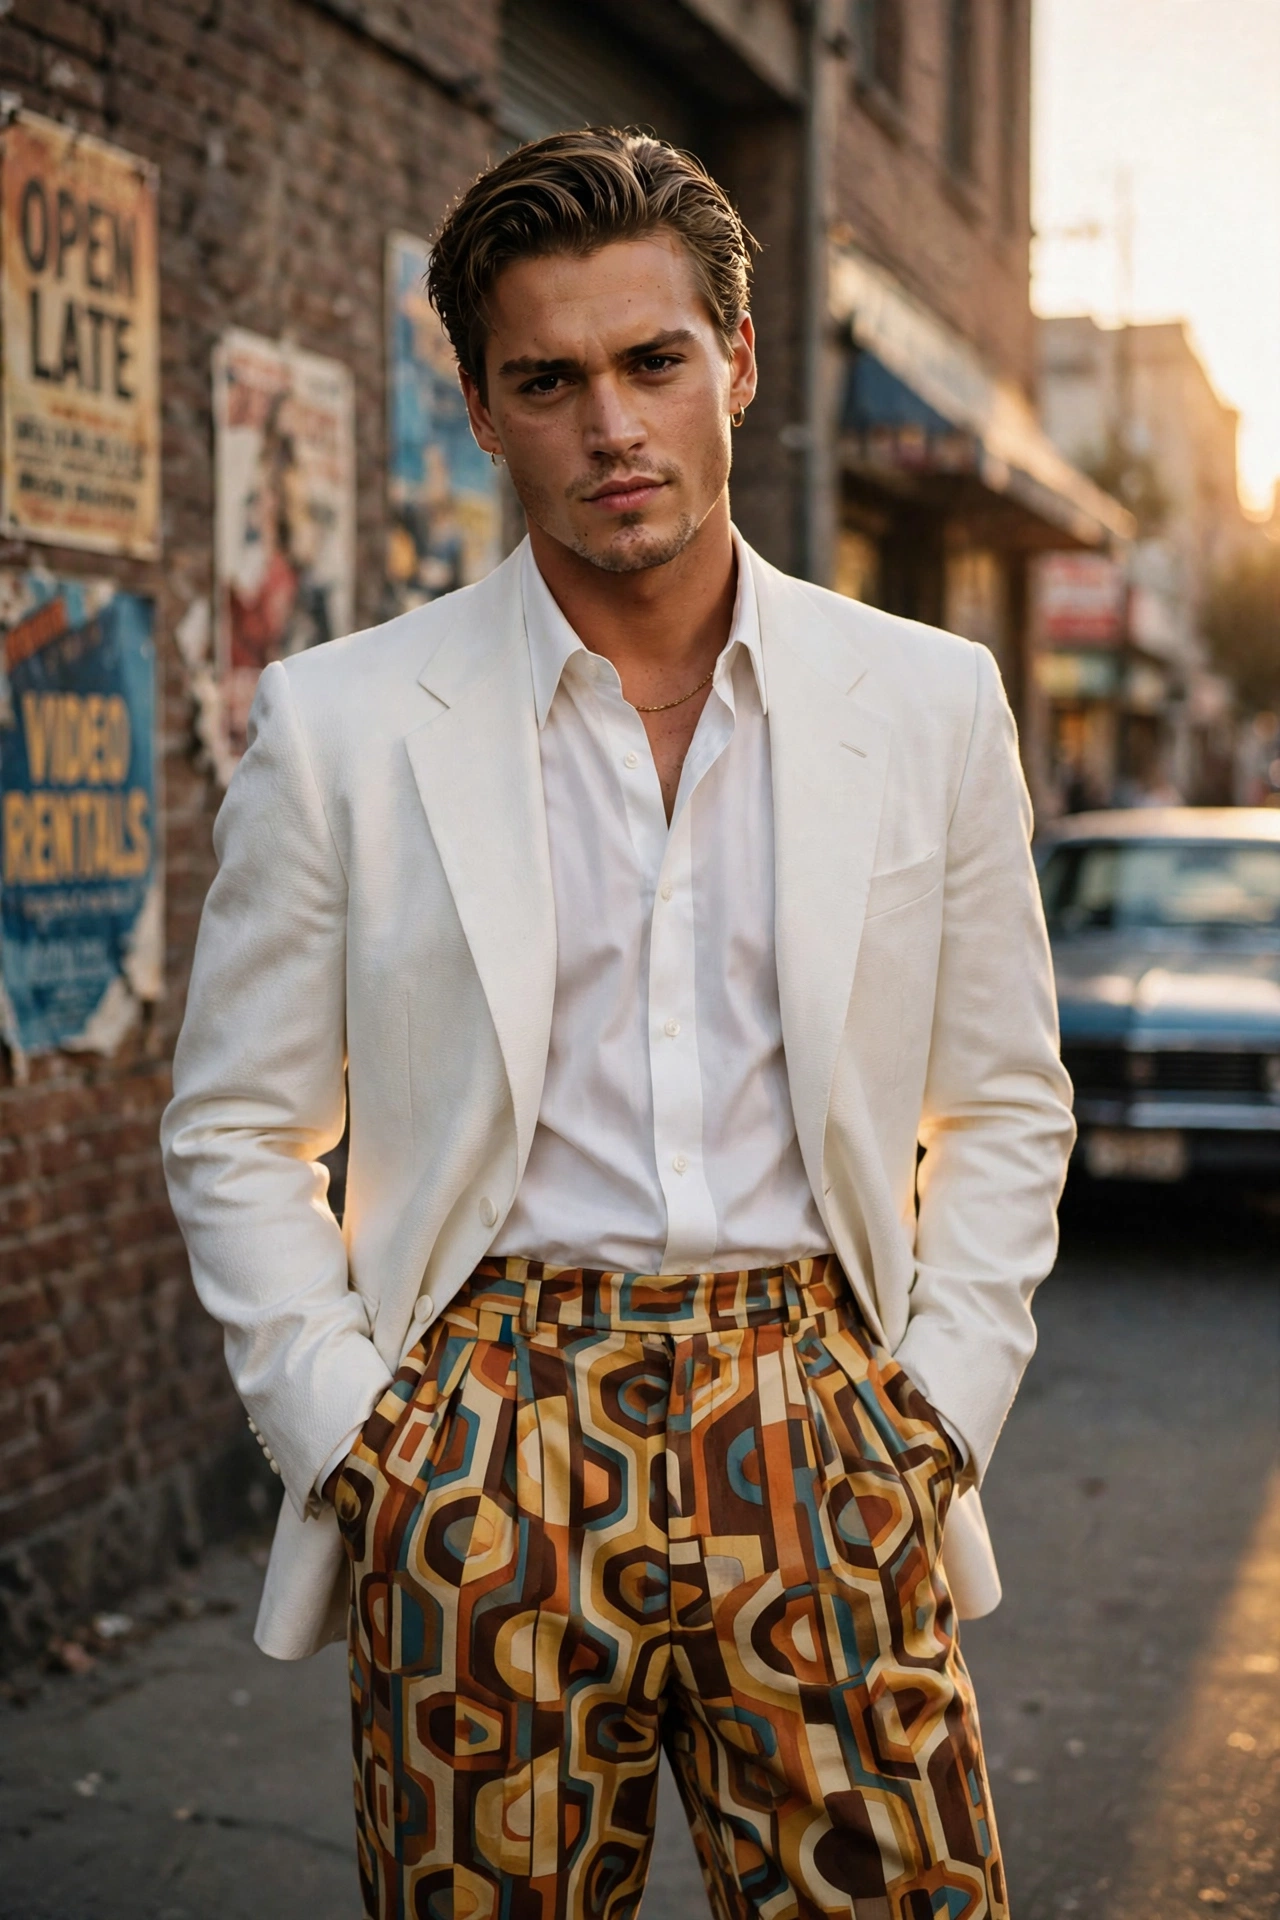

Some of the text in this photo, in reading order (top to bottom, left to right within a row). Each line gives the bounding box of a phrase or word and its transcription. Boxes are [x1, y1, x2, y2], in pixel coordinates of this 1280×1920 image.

[21, 177, 135, 297] OPEN
[31, 286, 132, 399] LATE
[23, 692, 131, 785] VIDEO
[4, 790, 149, 884] RENTALS
